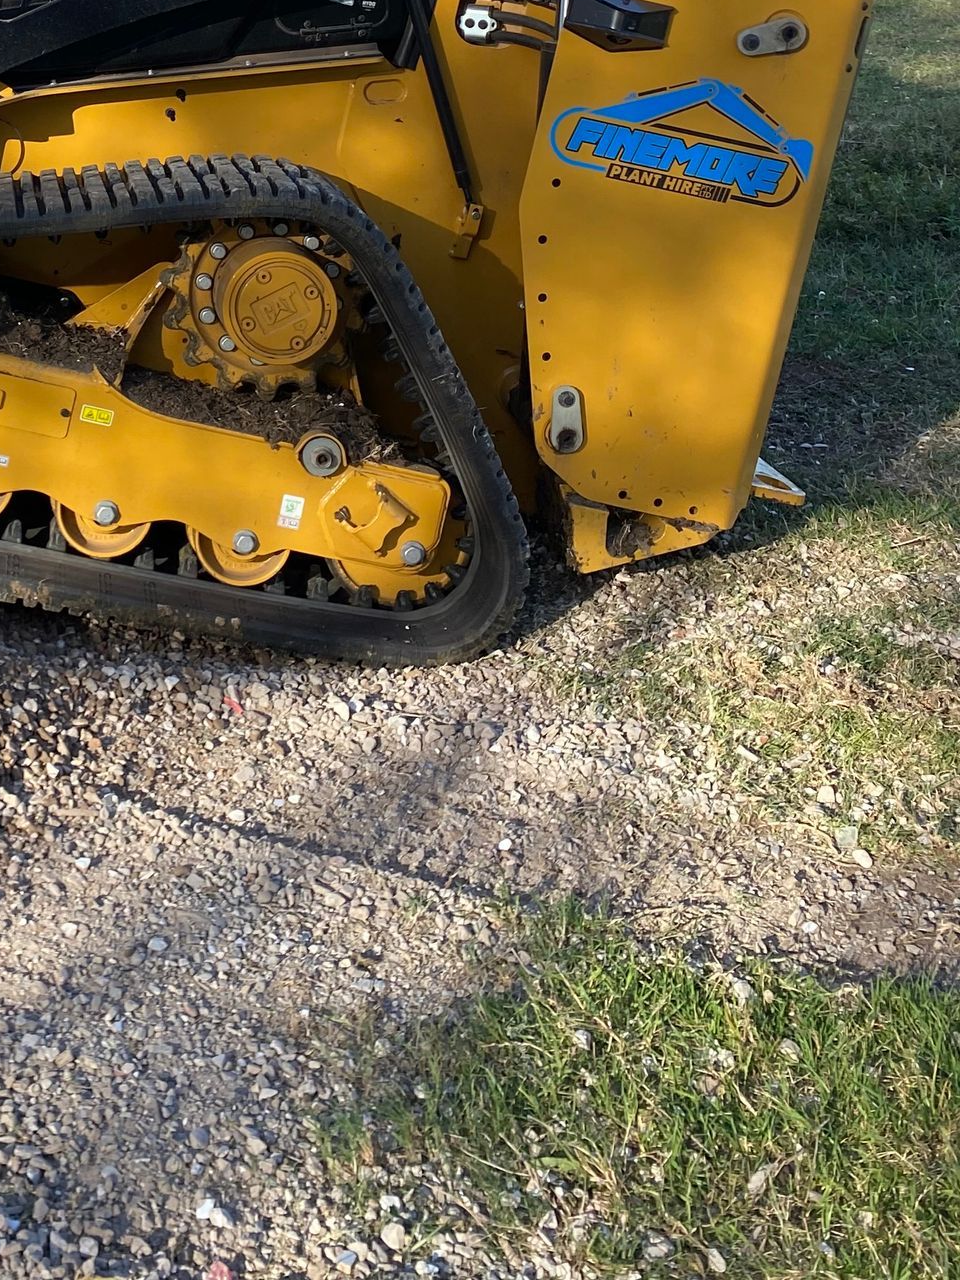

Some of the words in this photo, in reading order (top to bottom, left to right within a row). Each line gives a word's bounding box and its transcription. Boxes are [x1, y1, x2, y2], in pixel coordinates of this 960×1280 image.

[565, 116, 790, 199] FINEMORE
[608, 166, 661, 189] PLANT
[662, 176, 701, 197] HIRE
[698, 190, 712, 199] LTD
[257, 286, 304, 328] CAT
